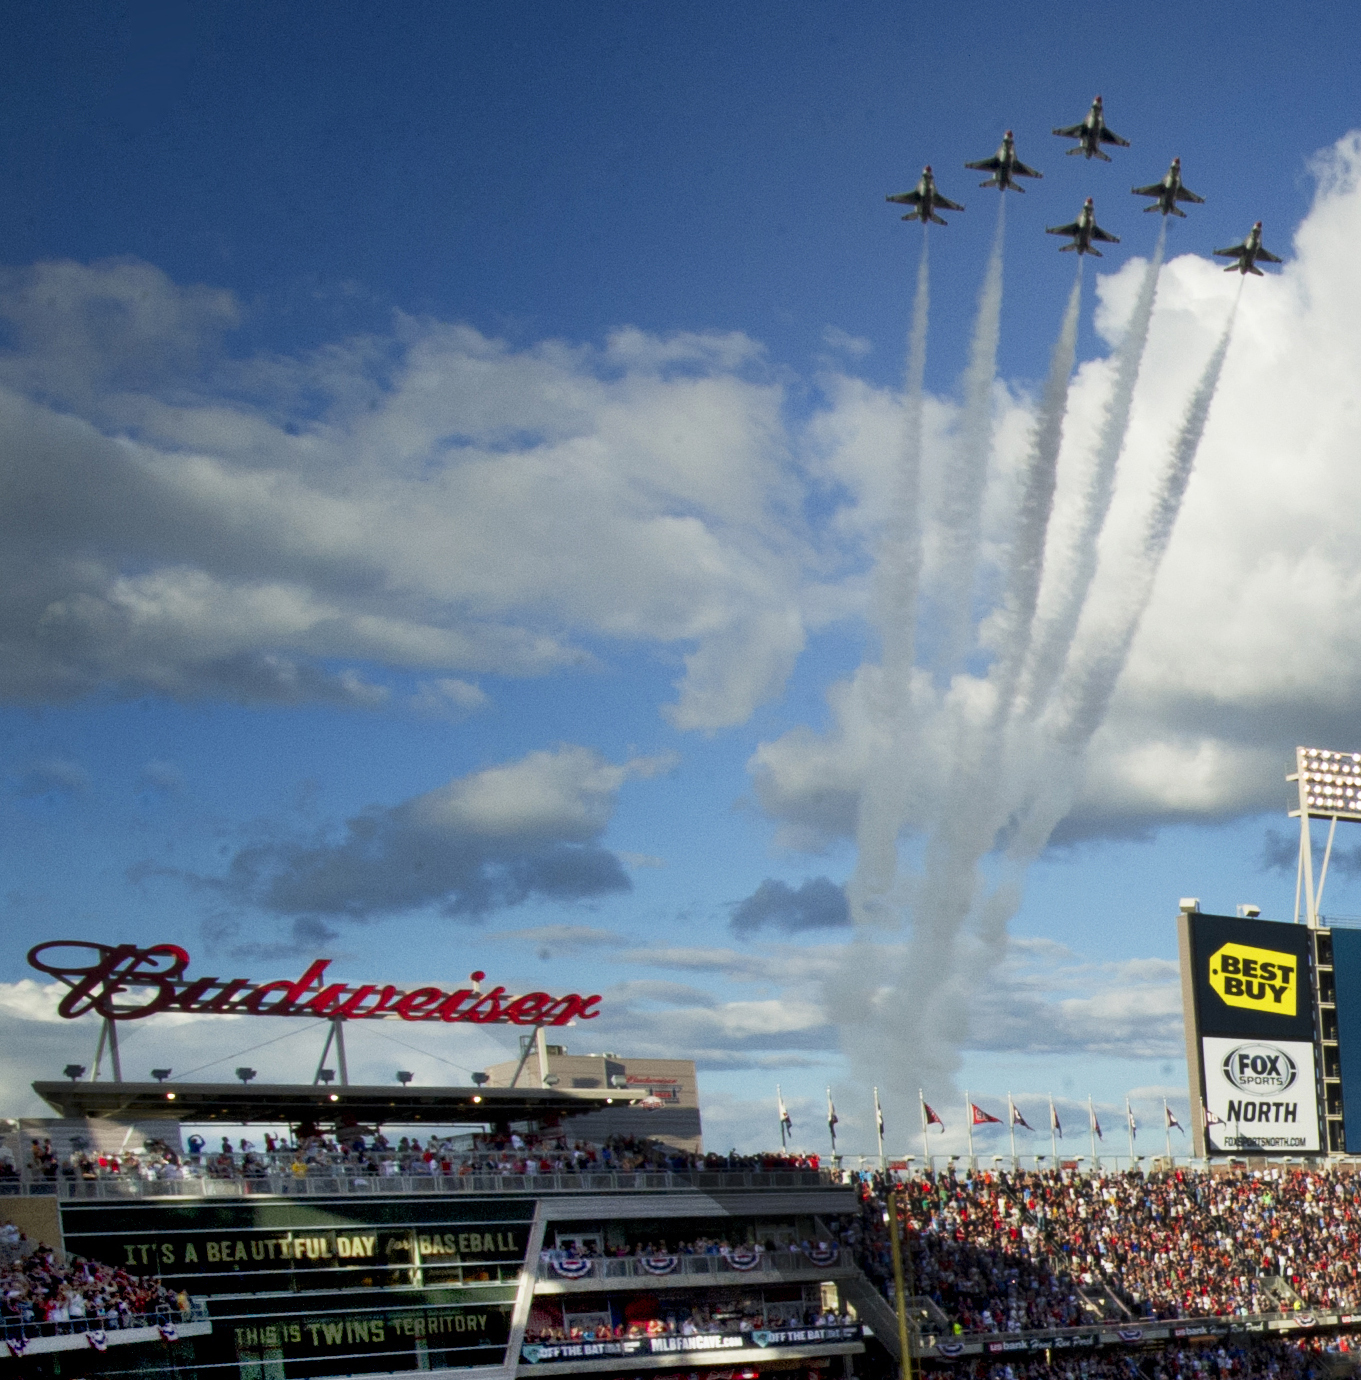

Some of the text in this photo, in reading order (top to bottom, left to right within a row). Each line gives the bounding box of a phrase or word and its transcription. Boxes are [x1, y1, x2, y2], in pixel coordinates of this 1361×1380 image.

[1220, 954, 1294, 984] BEST
[27, 940, 602, 1027] Budweiser
[1224, 976, 1289, 1004] BUY
[1238, 1054, 1282, 1076] FOX
[1239, 1076, 1284, 1086] SPORTS
[1227, 1100, 1298, 1123] NORTH
[1224, 1136, 1306, 1148] FOXSPORTSNORTH.COM
[124, 1242, 175, 1267] IT'S
[185, 1246, 199, 1265] A
[206, 1236, 333, 1263] BEAUTIFUL
[337, 1235, 376, 1259] DAY
[420, 1232, 519, 1256] BASEBALL
[235, 1315, 488, 1347] THIS IS TWINS TERRITORY
[768, 1332, 785, 1343] OFF
[787, 1331, 804, 1342] THE
[805, 1329, 826, 1341] BAT
[561, 1344, 582, 1357] THE
[584, 1342, 604, 1356] BAT
